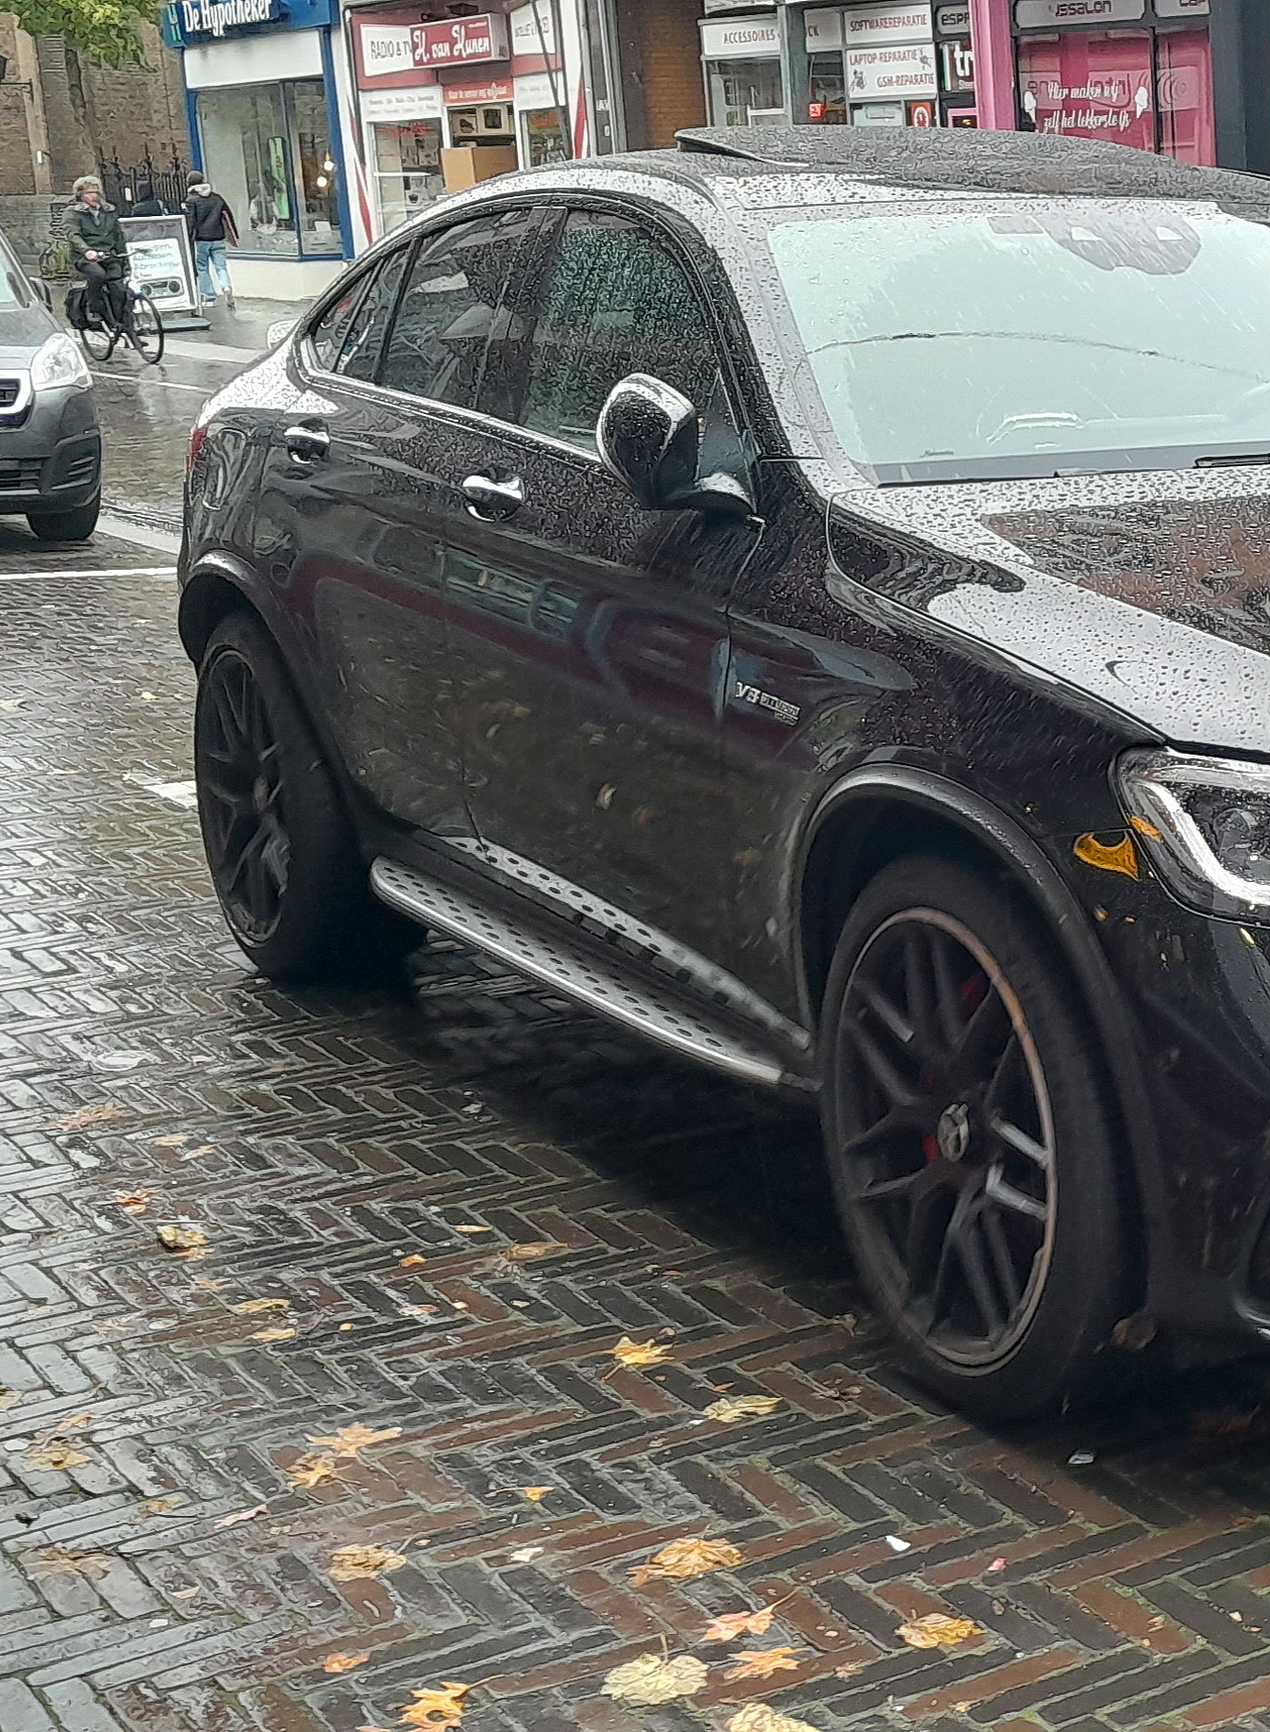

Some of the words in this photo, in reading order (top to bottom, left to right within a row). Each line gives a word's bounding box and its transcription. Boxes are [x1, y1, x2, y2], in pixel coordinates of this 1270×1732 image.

[182, 1, 201, 32] De
[201, 0, 272, 36] Hypotheker
[723, 29, 775, 44] ACCESSOIRES
